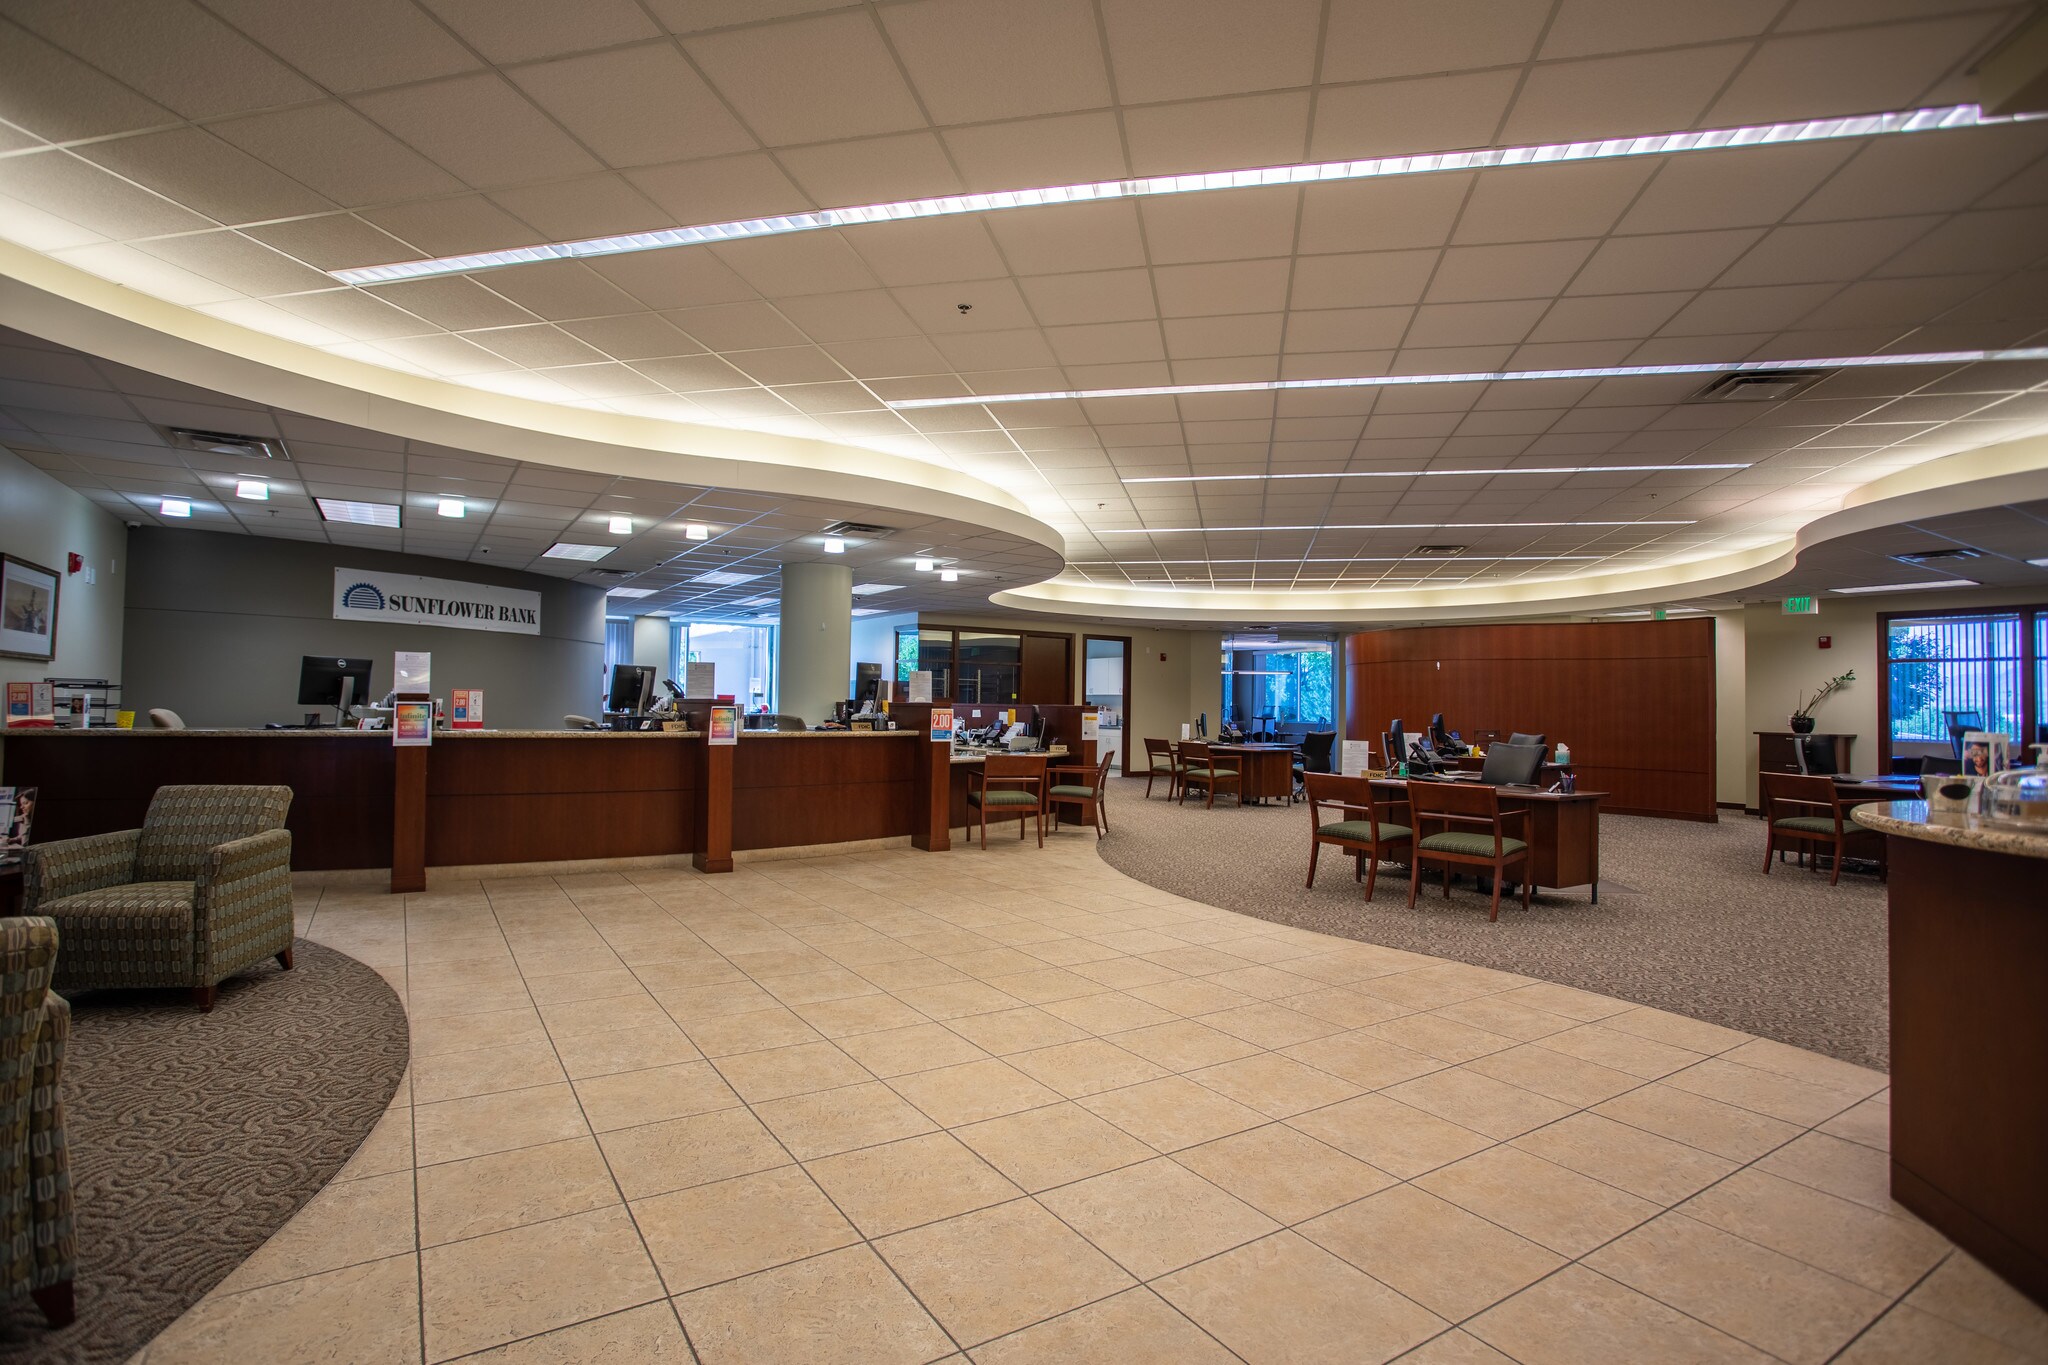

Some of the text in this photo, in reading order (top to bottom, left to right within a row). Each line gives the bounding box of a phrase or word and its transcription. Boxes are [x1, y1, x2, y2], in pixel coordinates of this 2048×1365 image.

[389, 594, 537, 624] SUNFLOWER BANK
[1788, 597, 1810, 612] EXIT
